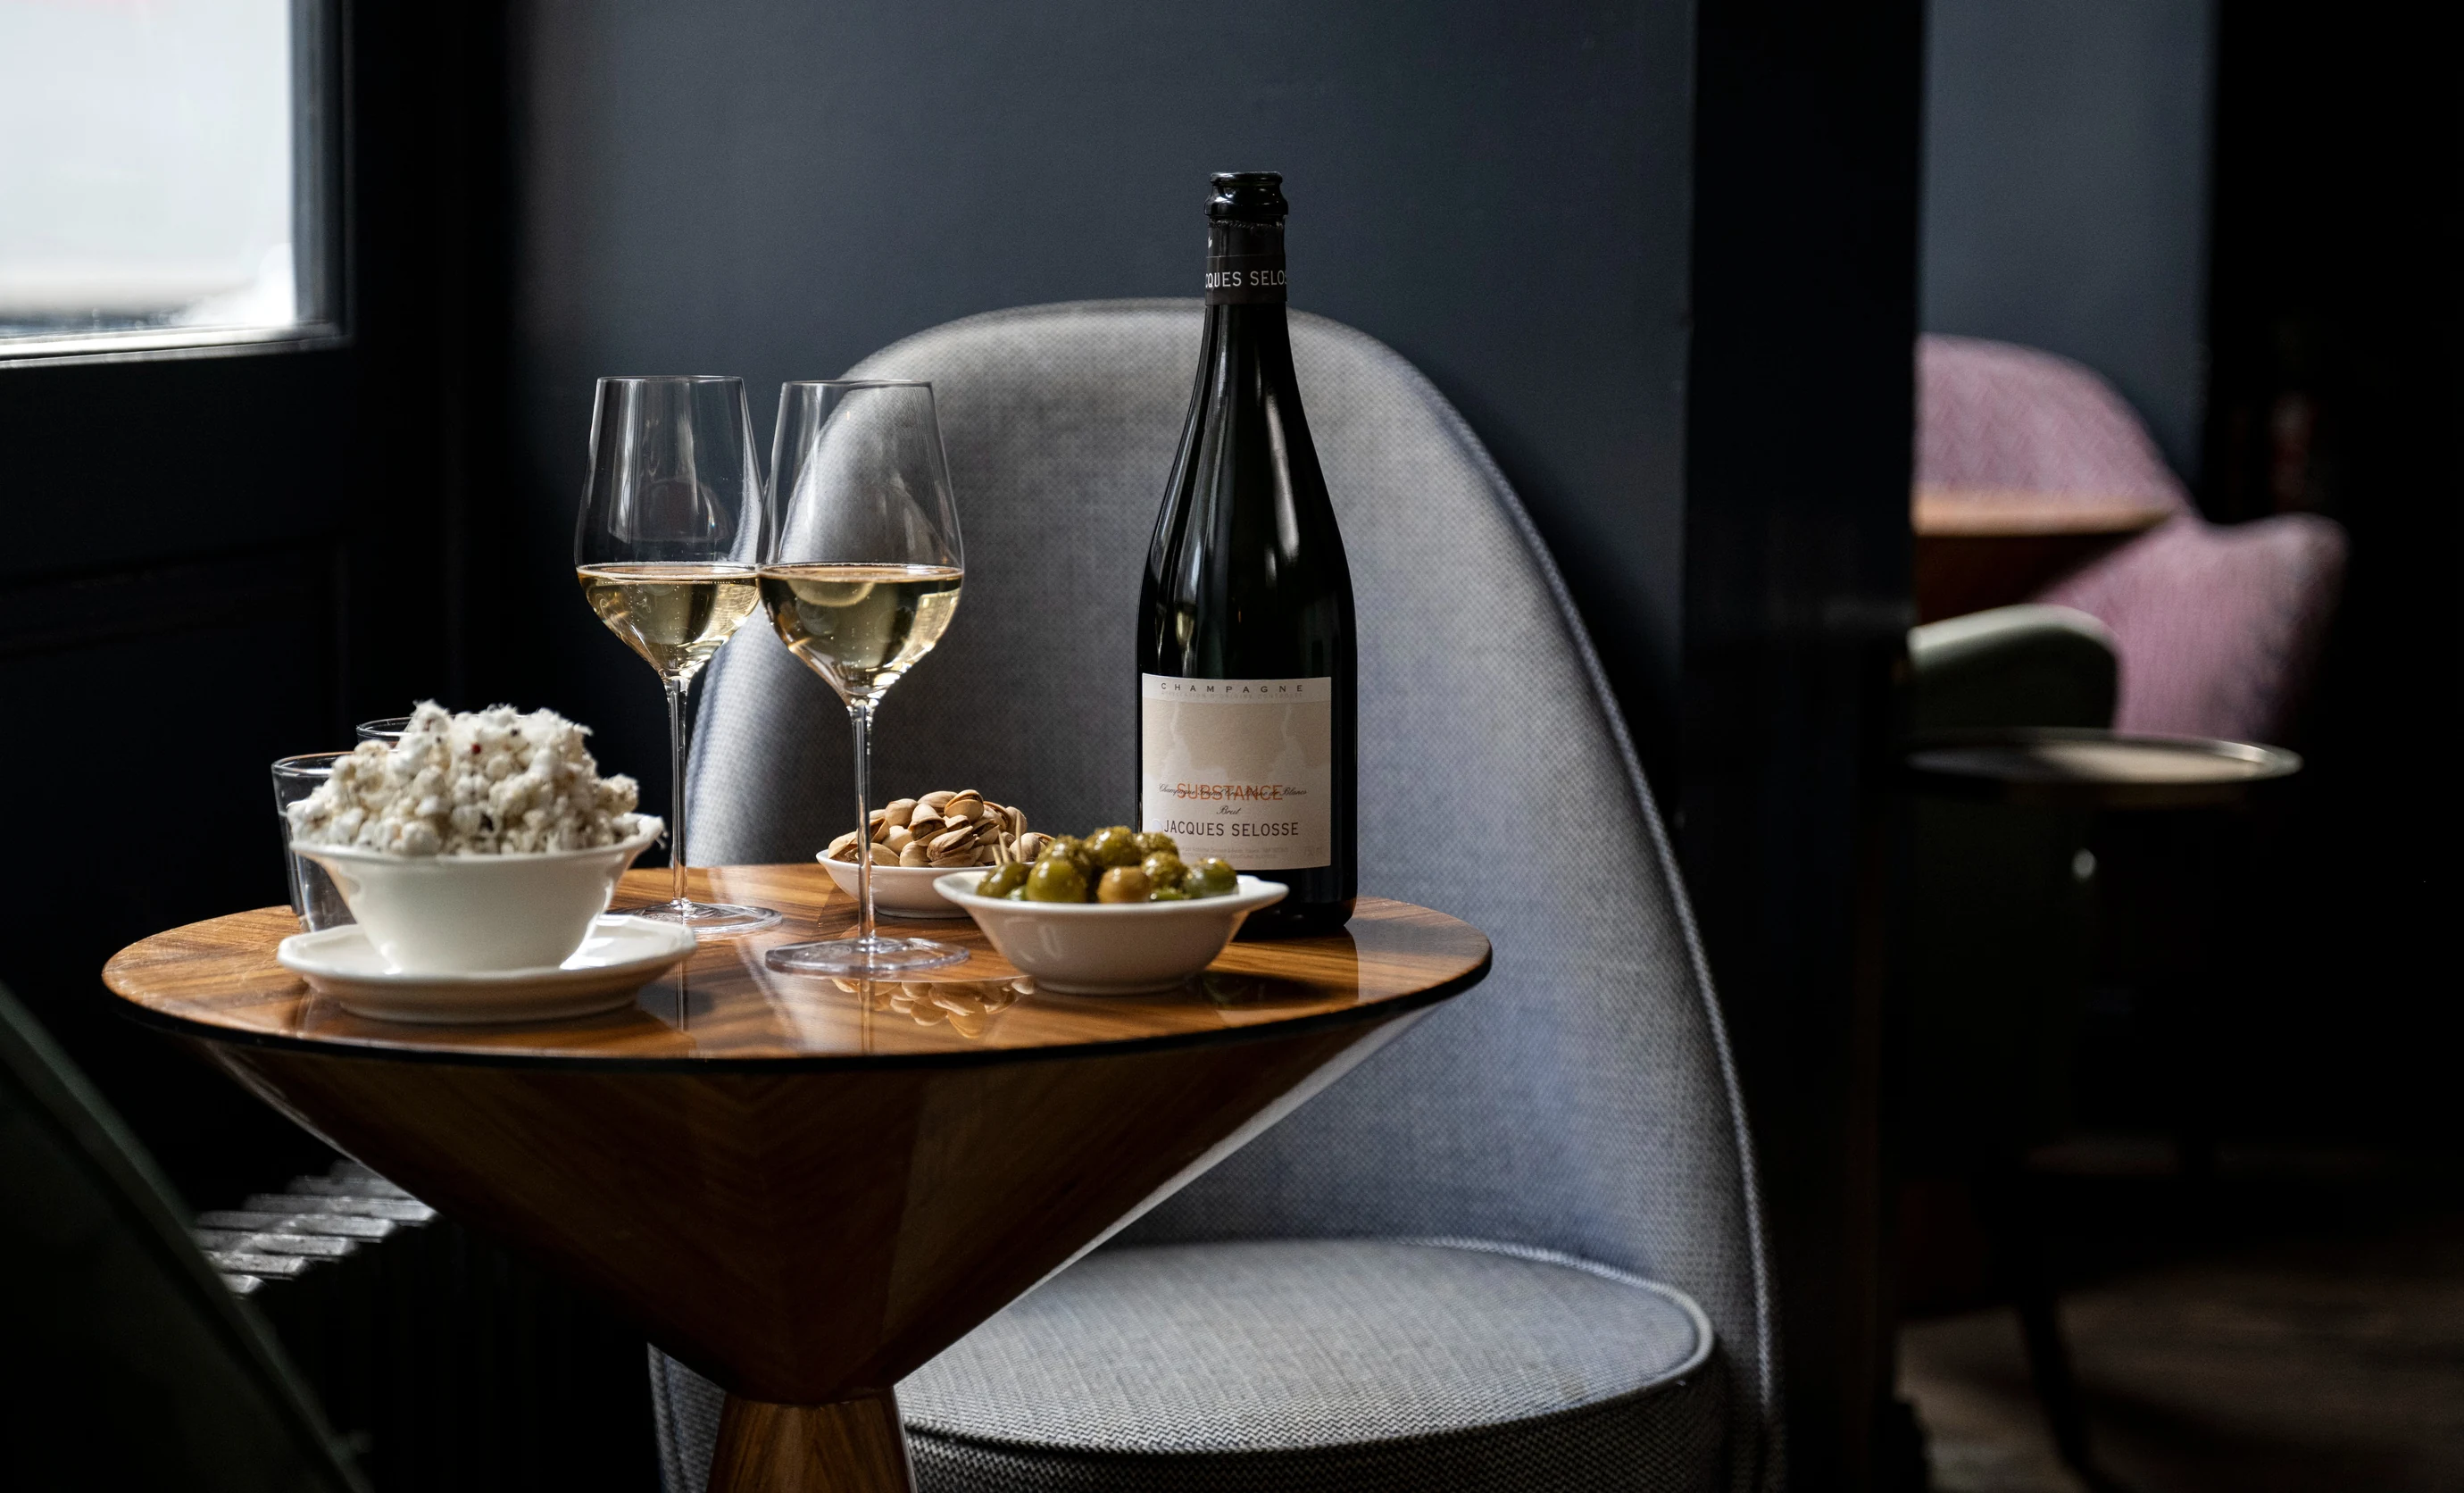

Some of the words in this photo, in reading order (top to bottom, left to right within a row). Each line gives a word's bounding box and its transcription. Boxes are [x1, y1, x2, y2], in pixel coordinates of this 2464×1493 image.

[1161, 682, 1303, 693] CHAMPAGNE
[1177, 782, 1284, 801] SUBSTANCE
[1216, 805, 1241, 815] Brut
[1163, 820, 1224, 837] JACQUES
[1231, 822, 1299, 837] SELOSSE
